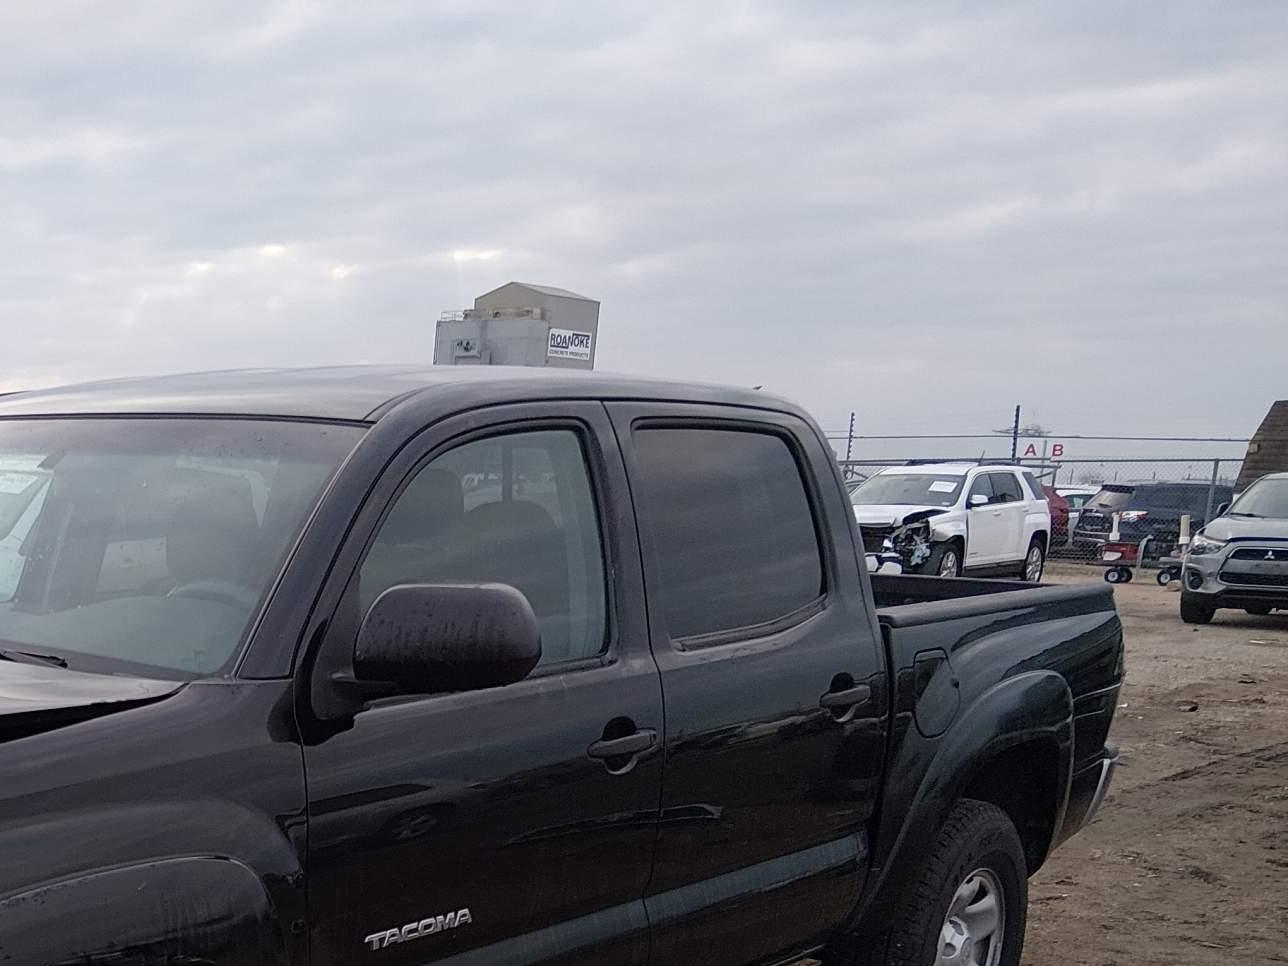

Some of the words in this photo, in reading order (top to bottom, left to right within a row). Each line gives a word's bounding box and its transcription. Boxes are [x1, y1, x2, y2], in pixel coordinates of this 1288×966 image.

[550, 333, 590, 349] ROANOKE
[1024, 443, 1037, 456] A
[1052, 444, 1064, 457] B
[364, 908, 472, 951] TACOMA
